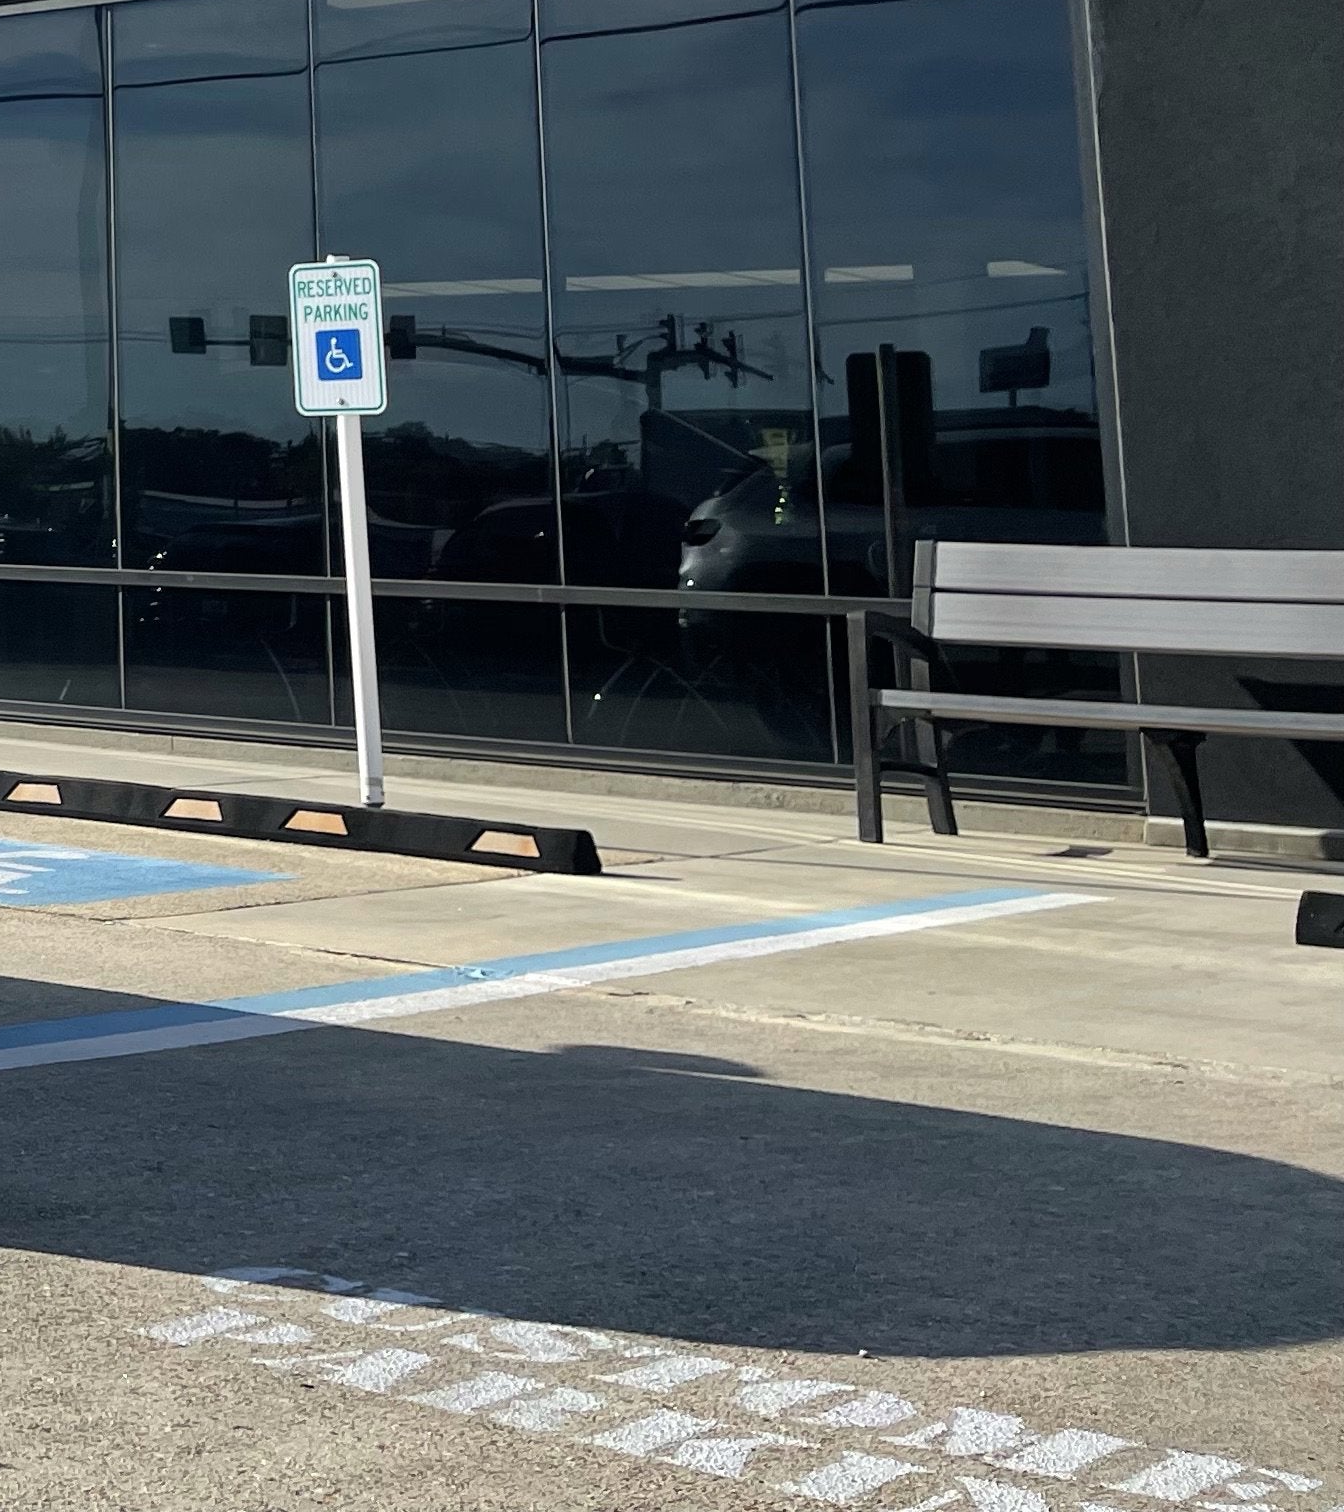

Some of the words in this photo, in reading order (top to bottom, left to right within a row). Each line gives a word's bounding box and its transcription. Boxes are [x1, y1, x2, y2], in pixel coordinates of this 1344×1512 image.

[296, 277, 372, 299] RESERVED
[303, 302, 369, 323] PARKING
[201, 1266, 1344, 1512] CUSTOME
